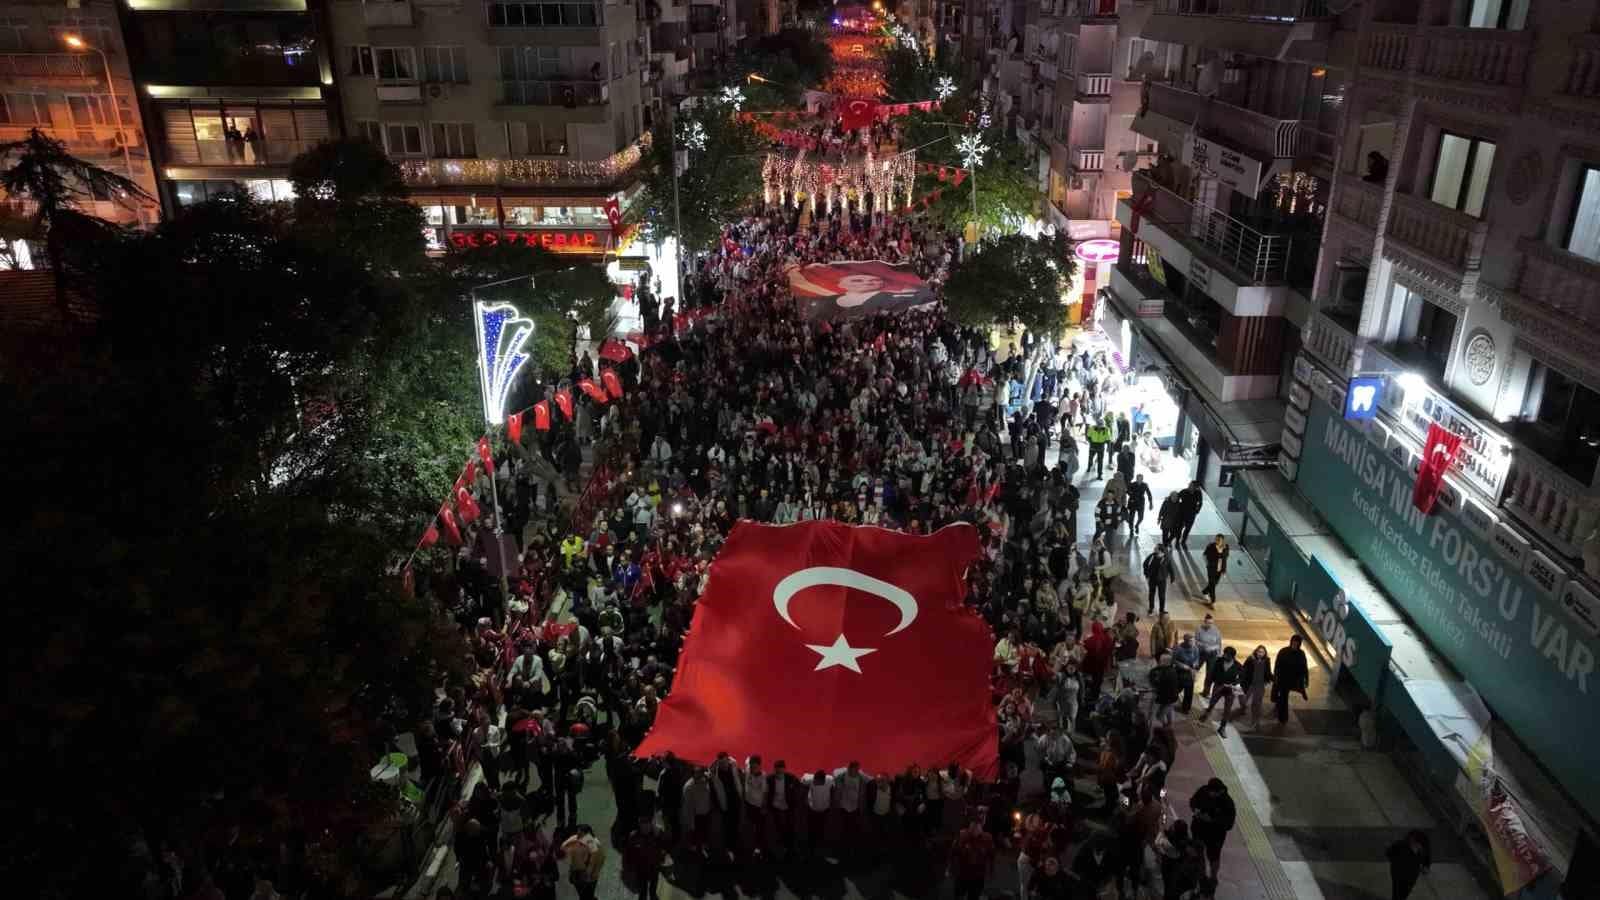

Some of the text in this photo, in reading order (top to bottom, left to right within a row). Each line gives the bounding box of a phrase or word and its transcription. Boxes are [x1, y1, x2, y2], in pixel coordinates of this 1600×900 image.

[1352, 487, 1381, 527] Kredi
[1420, 555, 1455, 604] Elden
[1312, 599, 1356, 667] FORS
[1430, 516, 1522, 620] FORS'U
[1530, 603, 1594, 693] VAR
